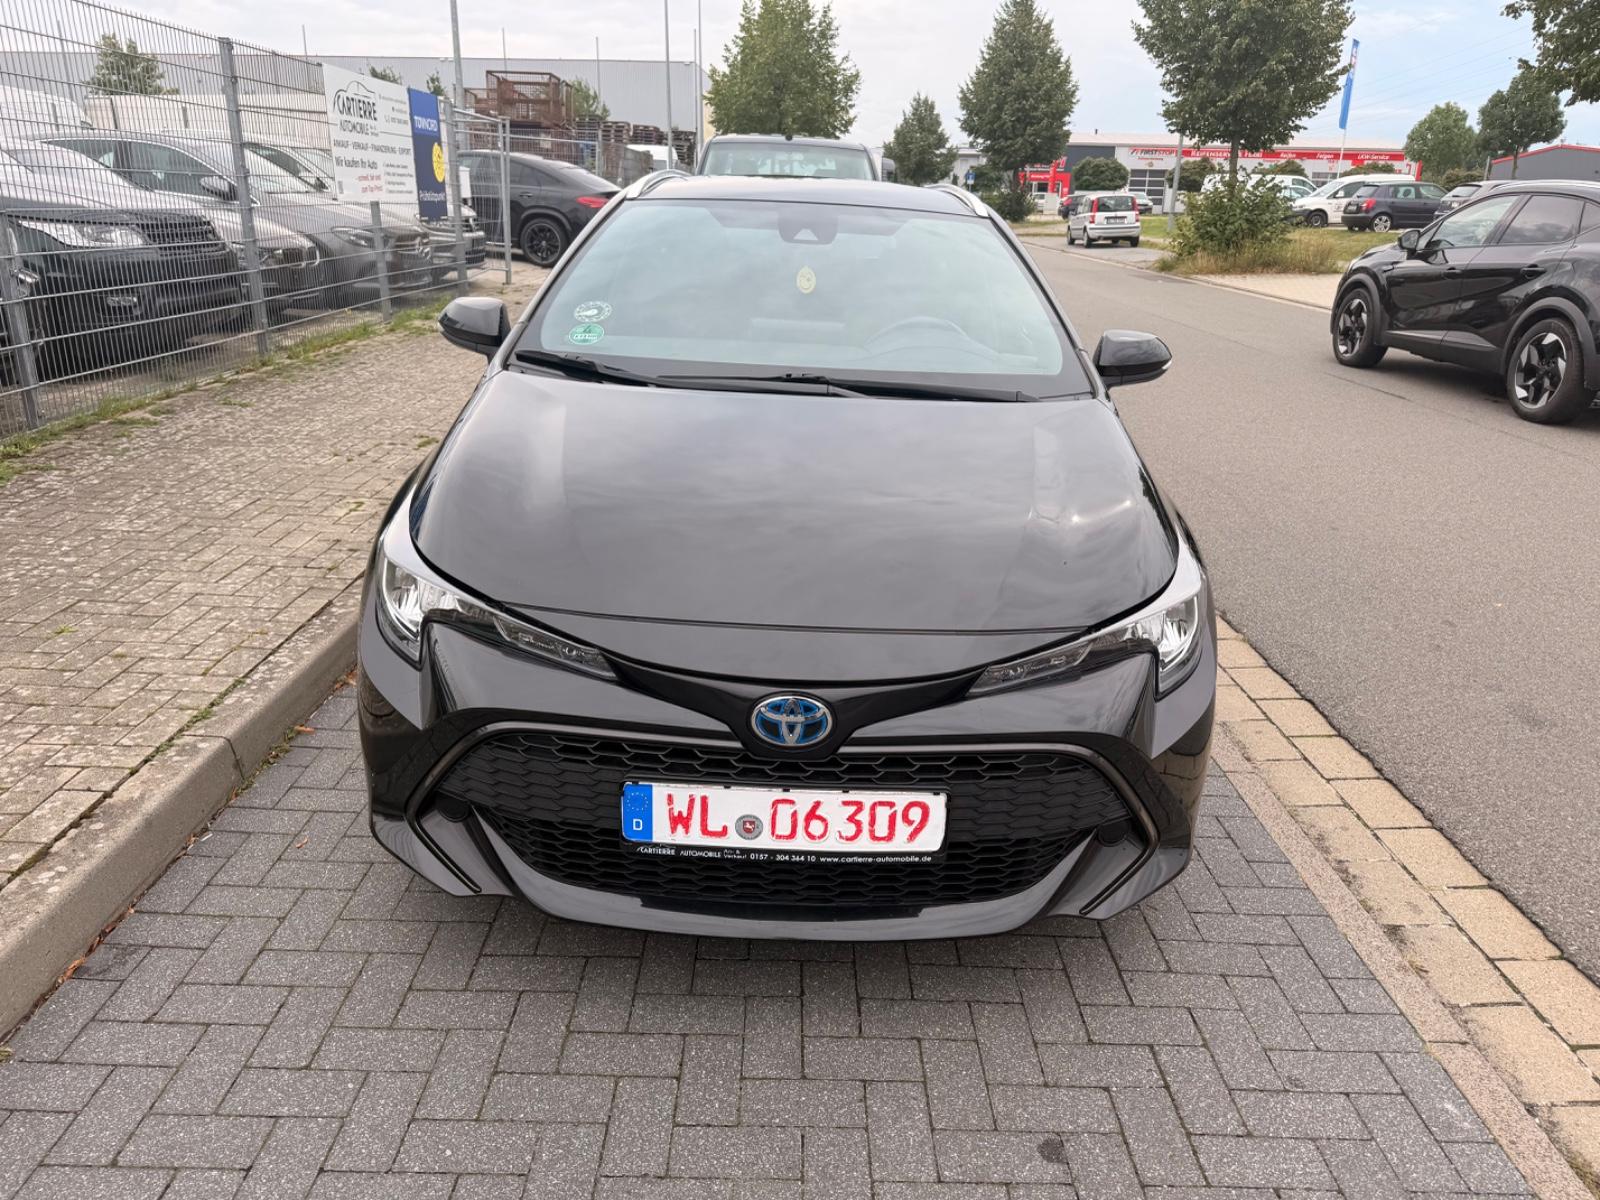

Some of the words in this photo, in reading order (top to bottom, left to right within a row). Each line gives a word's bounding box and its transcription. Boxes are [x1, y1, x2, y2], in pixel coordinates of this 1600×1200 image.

[336, 94, 378, 121] CARTIERRE
[632, 819, 643, 831] D
[666, 793, 729, 838] WL
[770, 798, 931, 843] 06309
[679, 849, 722, 858] AUTOMOBILE
